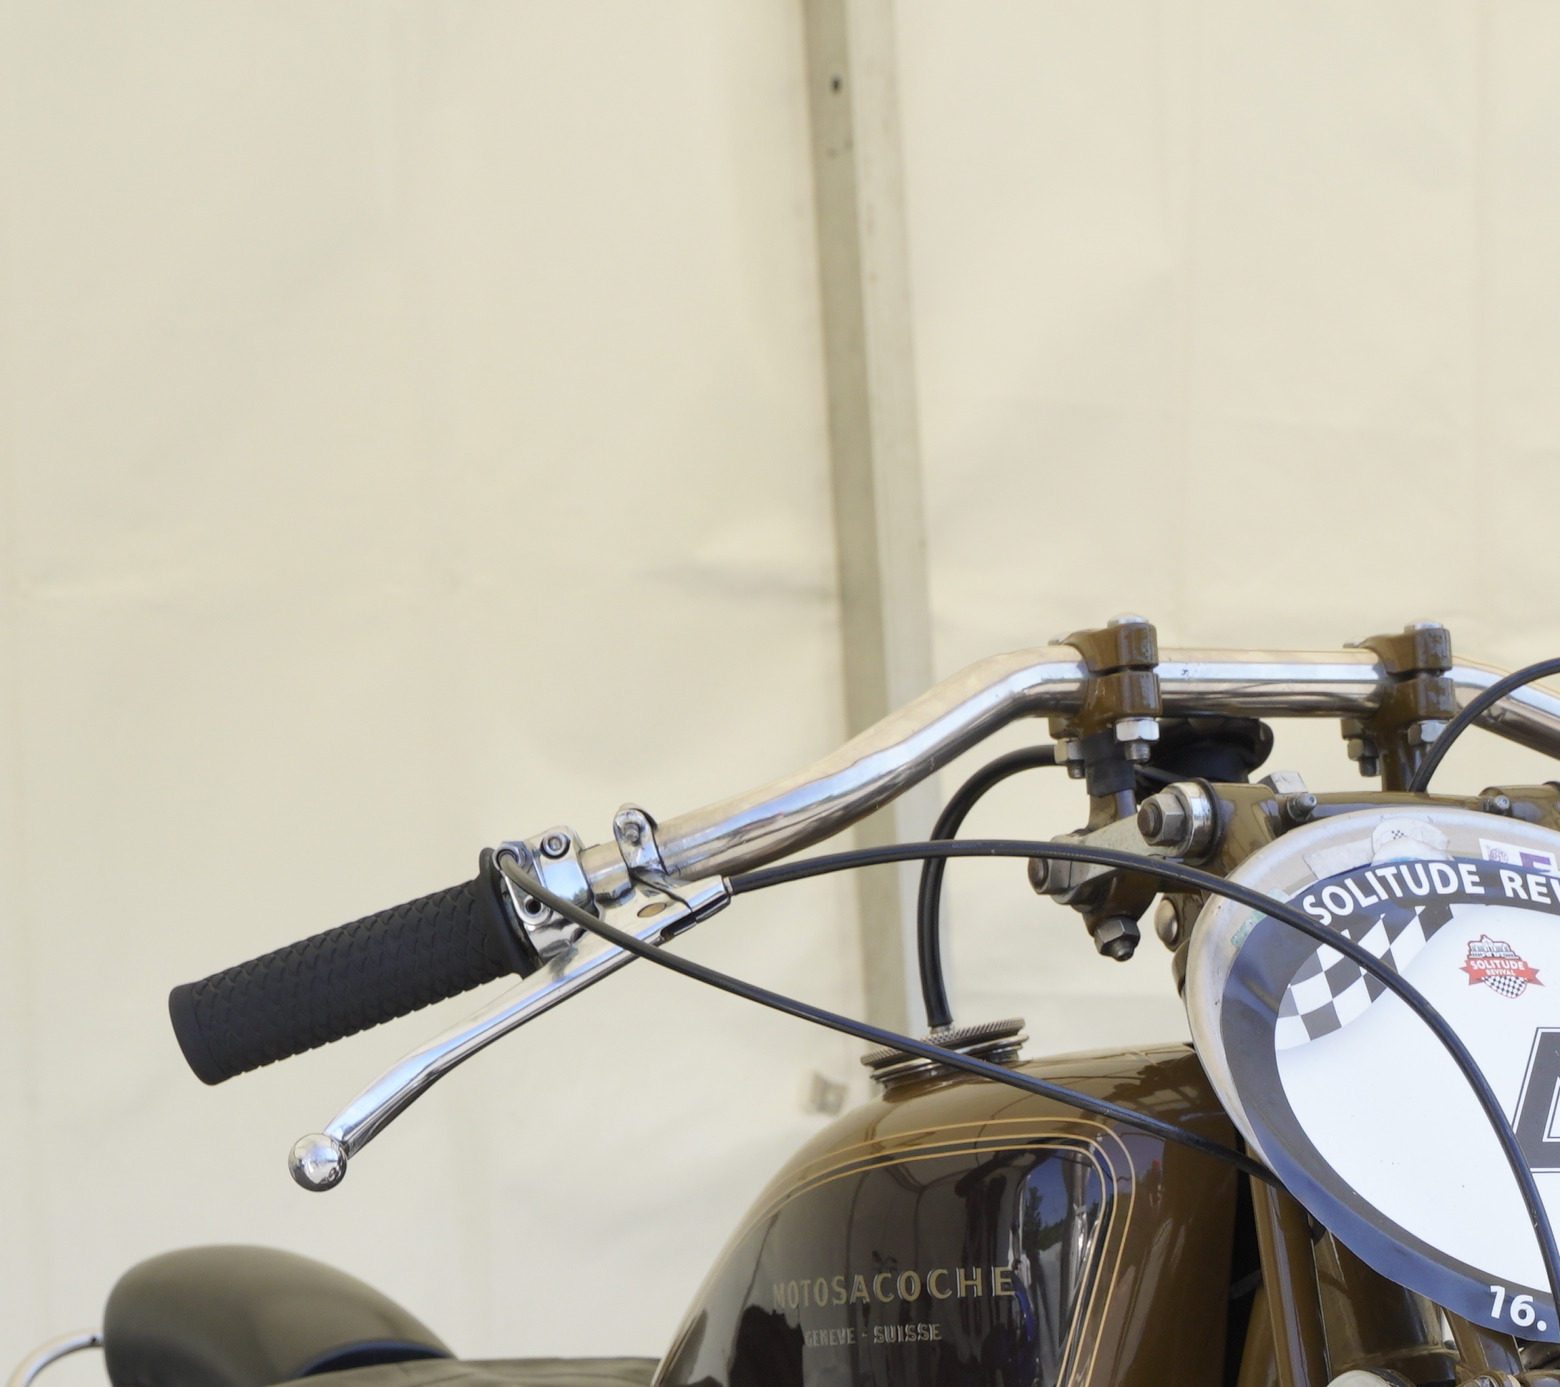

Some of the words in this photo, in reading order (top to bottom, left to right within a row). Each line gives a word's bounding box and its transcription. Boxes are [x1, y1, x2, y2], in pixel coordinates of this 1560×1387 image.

[1302, 862, 1485, 926] SOLITUDE
[1470, 959, 1526, 971] SOLITUDE
[1485, 968, 1517, 976] REVIVAL
[772, 1265, 1017, 1309] MOTOSACOCHE
[1489, 1285, 1547, 1332] 16.
[873, 1322, 943, 1344] SUISSE
